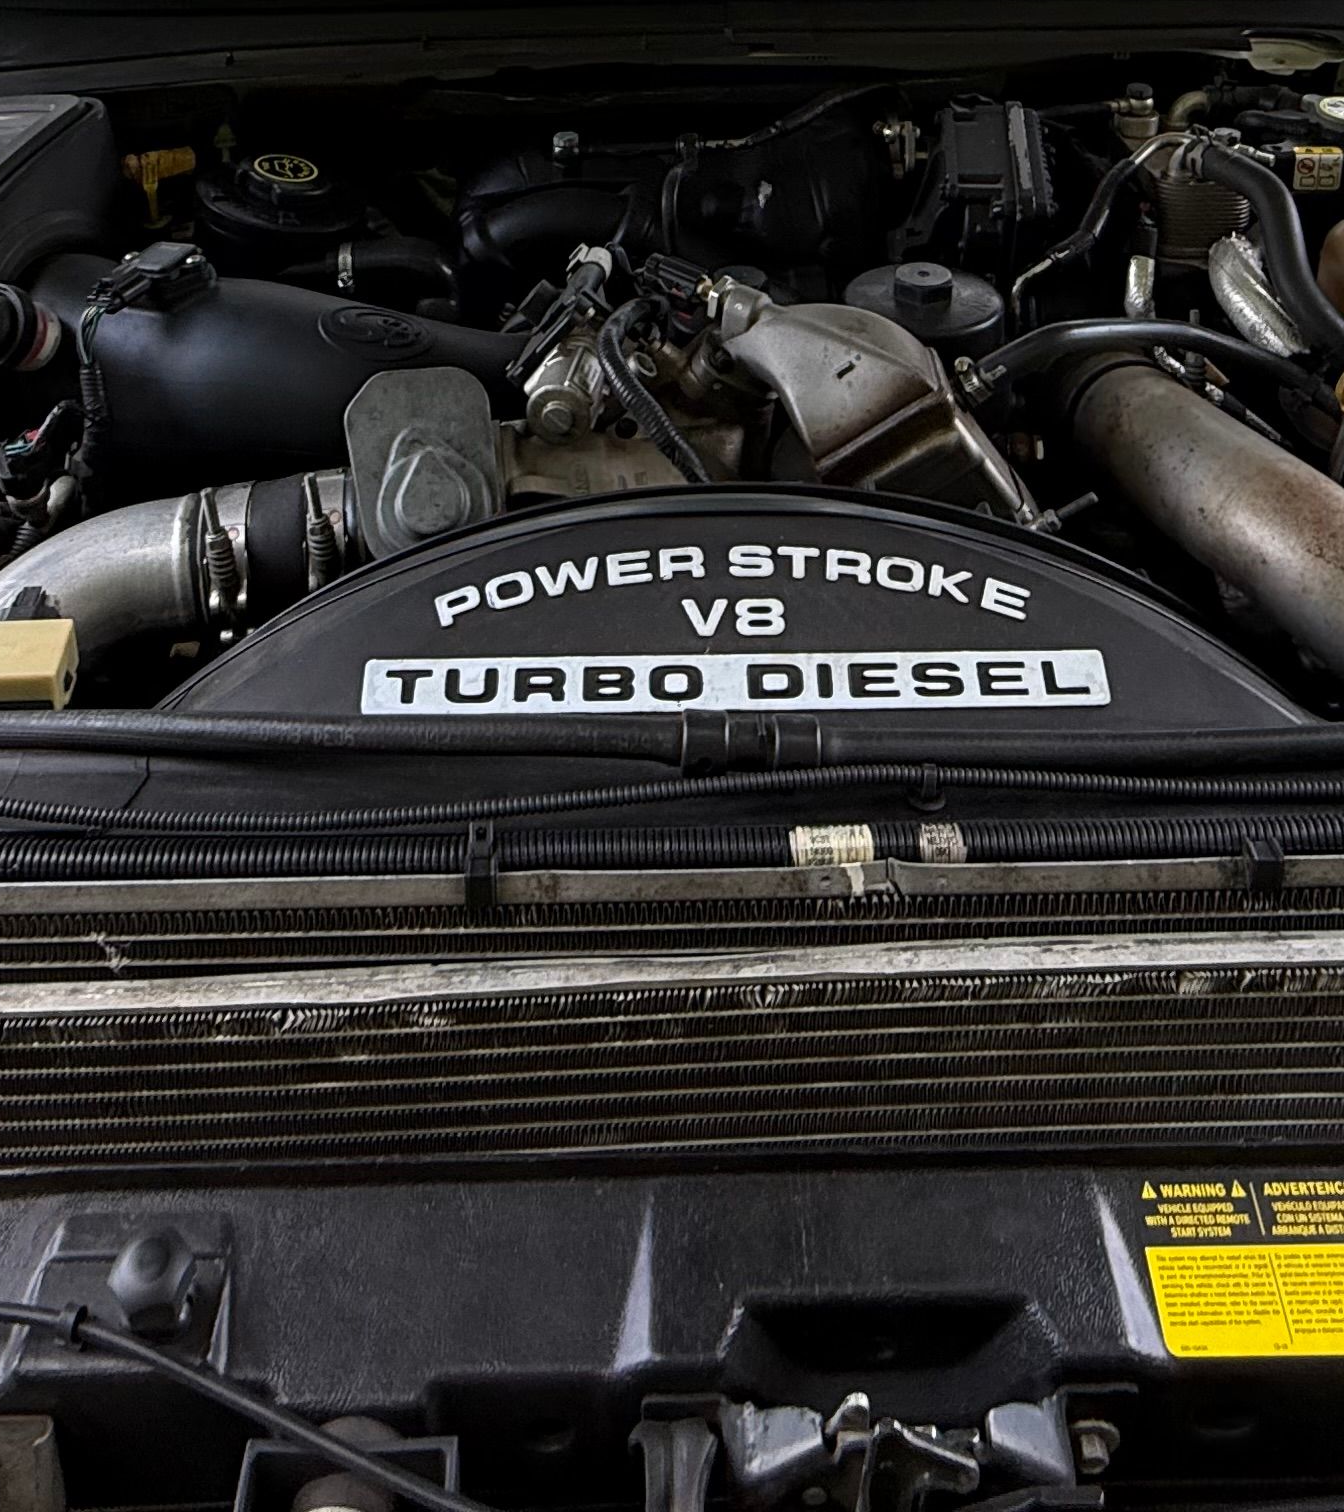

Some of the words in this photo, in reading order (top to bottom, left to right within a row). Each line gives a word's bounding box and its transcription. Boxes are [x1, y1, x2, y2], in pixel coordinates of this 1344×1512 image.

[434, 546, 705, 628] POWER
[726, 545, 1032, 621] STROKE
[681, 597, 786, 637] V8
[384, 663, 704, 705] TURBO
[746, 660, 1094, 701] DIESEL
[1157, 1202, 1192, 1214] VEHICLE
[1192, 1201, 1234, 1213] EQUIPPED
[1159, 1182, 1226, 1198] WARNING
